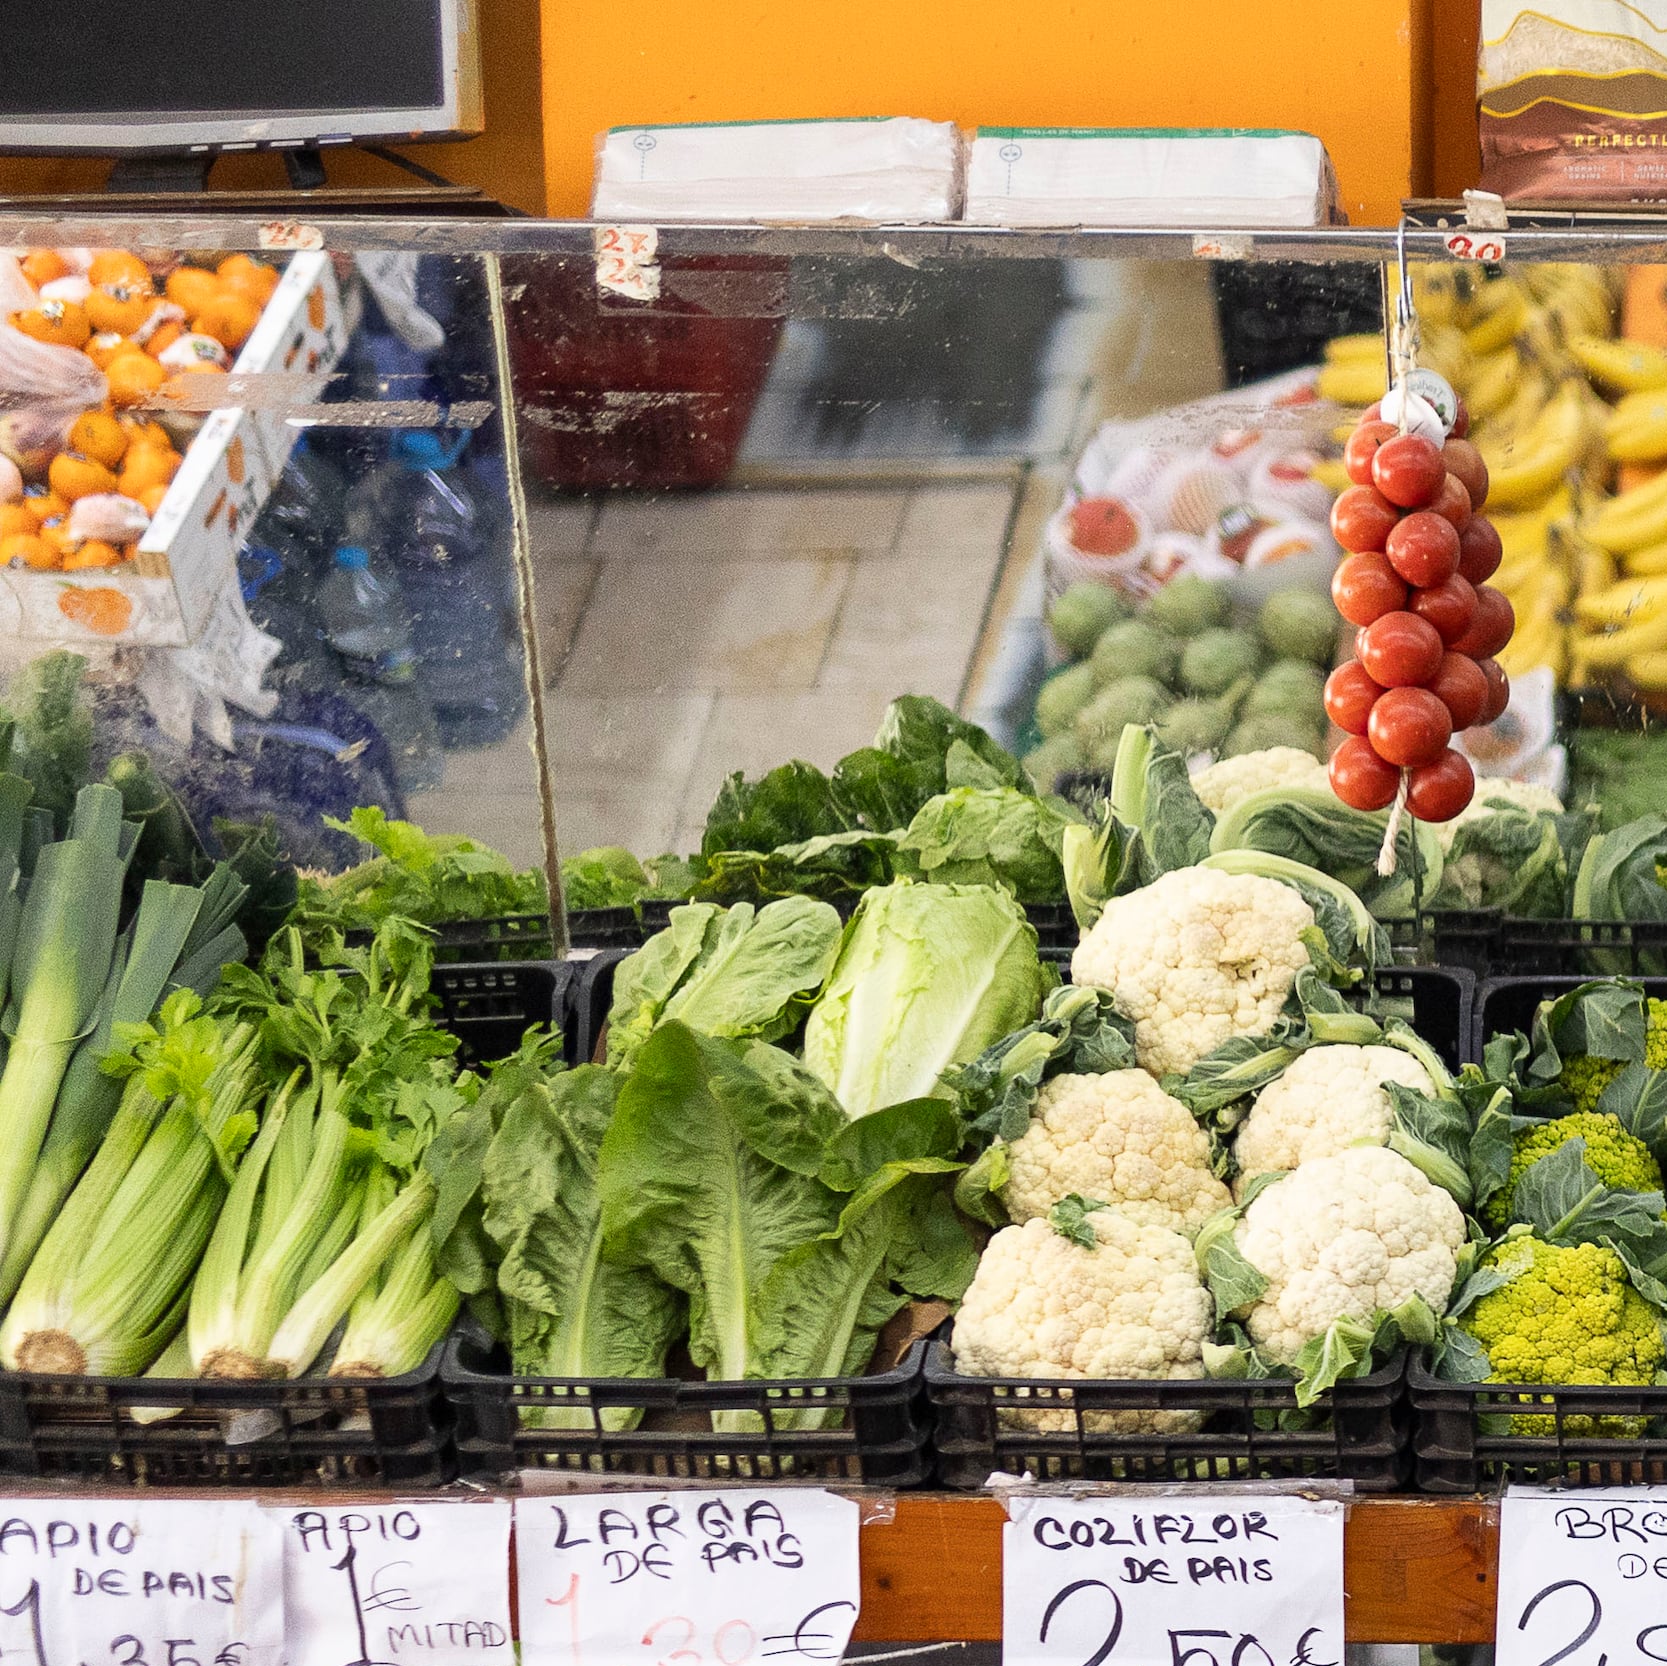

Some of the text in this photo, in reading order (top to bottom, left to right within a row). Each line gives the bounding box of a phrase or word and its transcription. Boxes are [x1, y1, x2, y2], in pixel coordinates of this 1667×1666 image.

[292, 1509, 422, 1552] APIO
[550, 1498, 786, 1550] LARGA
[603, 1532, 806, 1584] DE PAIS
[1119, 1555, 1273, 1585] DE PAIS
[72, 1567, 235, 1604] DE PAIS
[387, 1620, 507, 1655] MITAD
